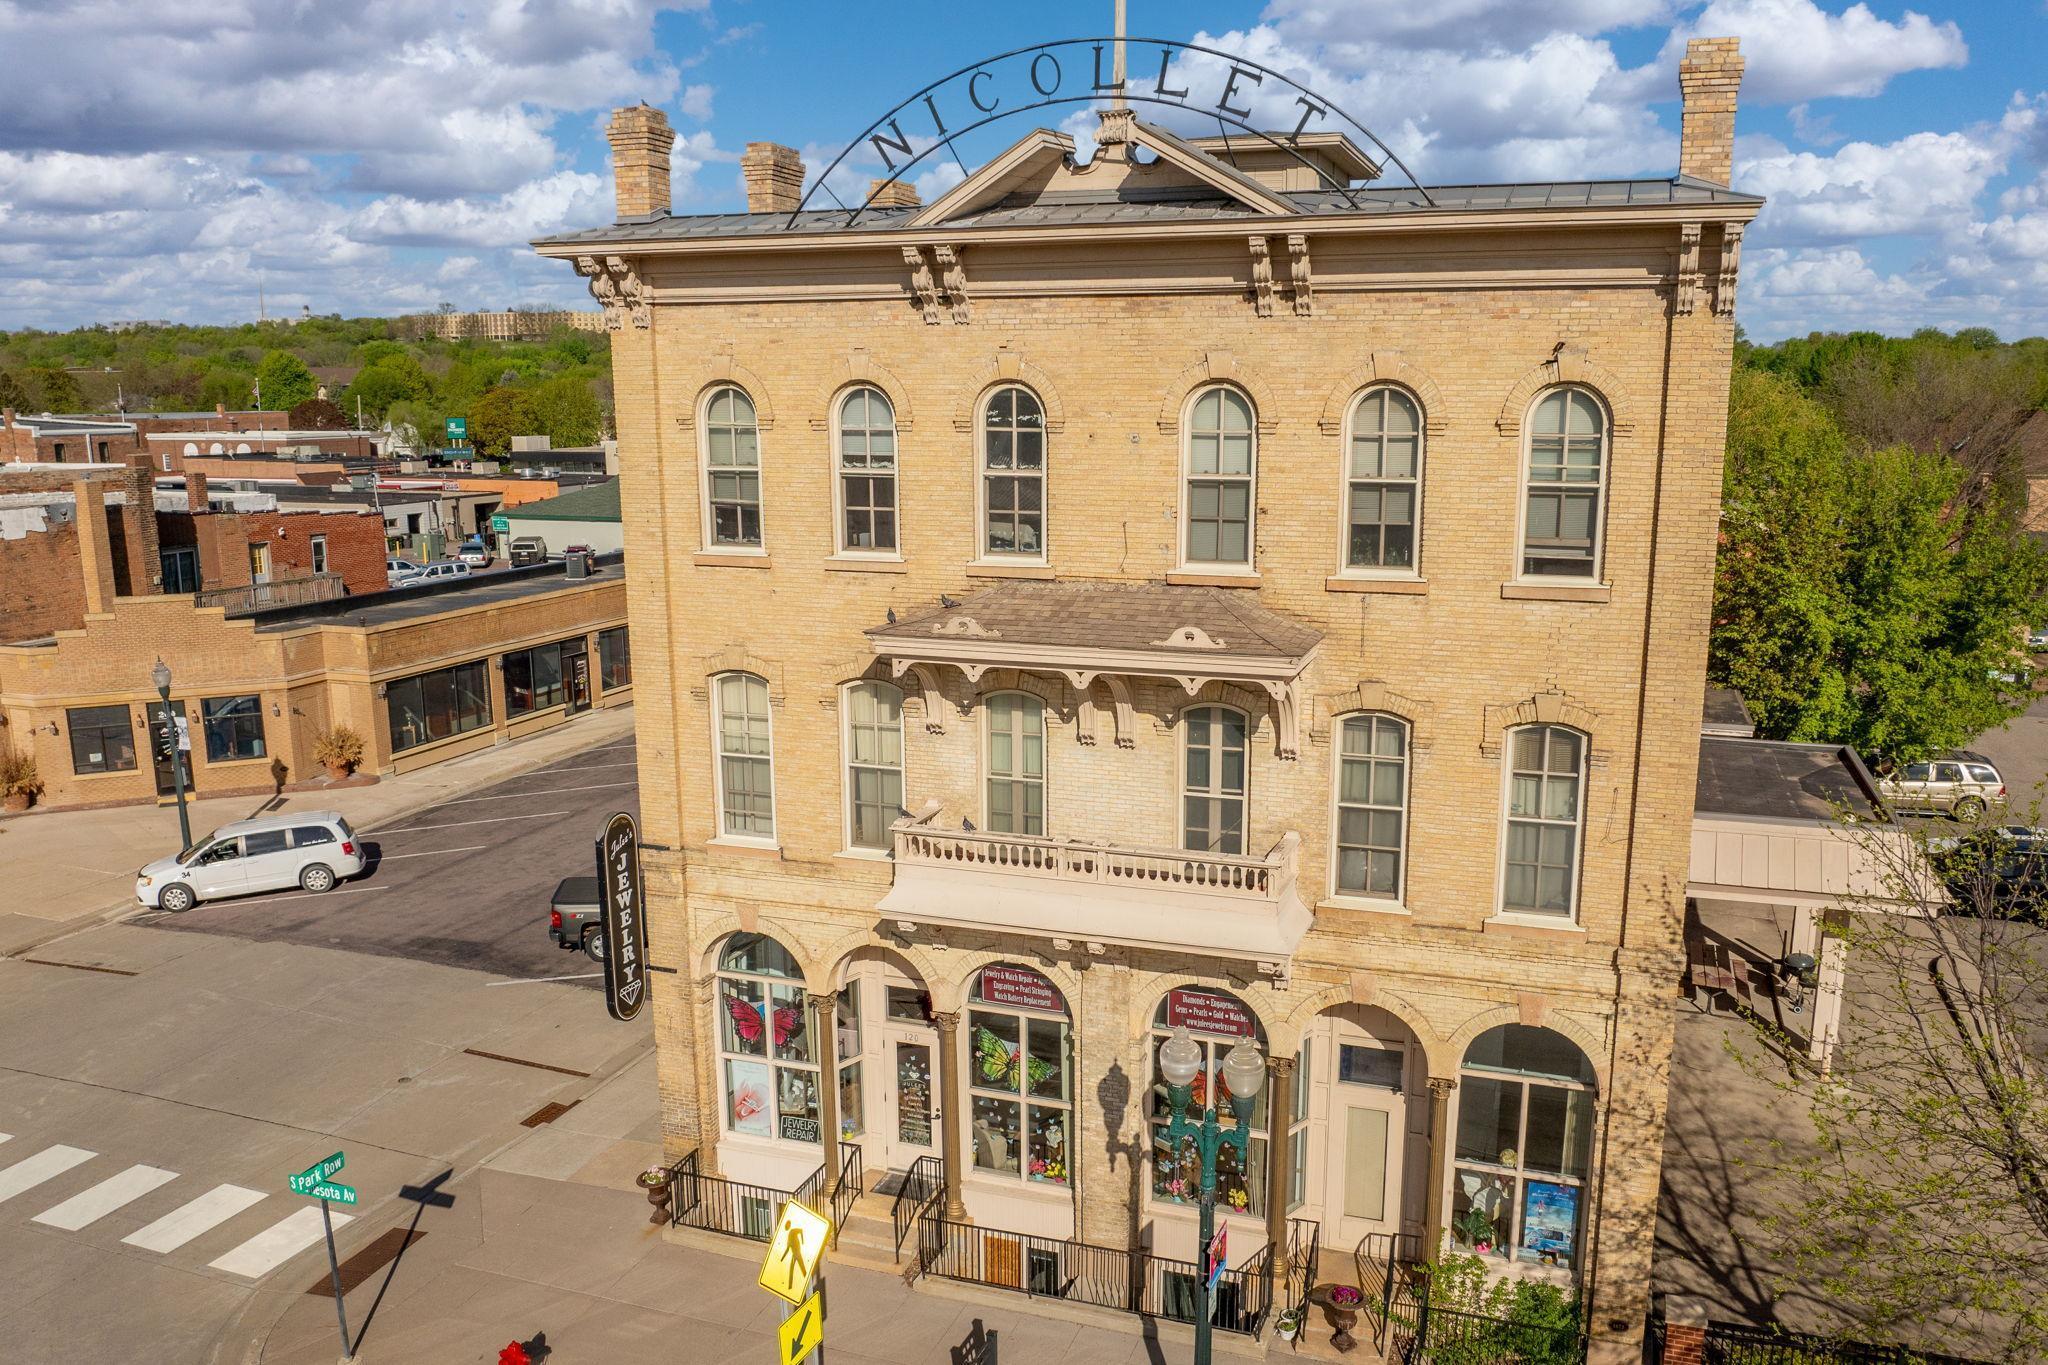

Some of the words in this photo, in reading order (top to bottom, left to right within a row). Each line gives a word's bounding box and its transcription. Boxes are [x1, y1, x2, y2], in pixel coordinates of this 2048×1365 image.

[868, 46, 1327, 172] NICOLLET
[181, 871, 191, 879] 34
[616, 853, 636, 983] JEWELRY
[984, 969, 1000, 980] Jewelry
[1005, 972, 1018, 981] Watch
[1019, 974, 1032, 984] Repair
[993, 981, 1015, 992] Engraving
[1020, 985, 1031, 993] Pearl
[1032, 986, 1052, 997] Stringing
[994, 992, 1007, 1001] Watch
[1008, 994, 1023, 1003] Battery
[1023, 996, 1052, 1007] Replacement
[1182, 994, 1205, 1006] Diamonds
[1175, 1005, 1187, 1014] Gems
[1194, 1007, 1207, 1017] Pearls
[1213, 1010, 1223, 1019] Gold
[904, 1032, 918, 1041] 120
[783, 1118, 818, 1132] JEWELRY
[786, 1129, 815, 1141] REPAIR
[290, 1176, 296, 1189] S
[298, 1169, 322, 1190] Park
[324, 1157, 342, 1176] Row
[343, 1188, 354, 1202] Av
